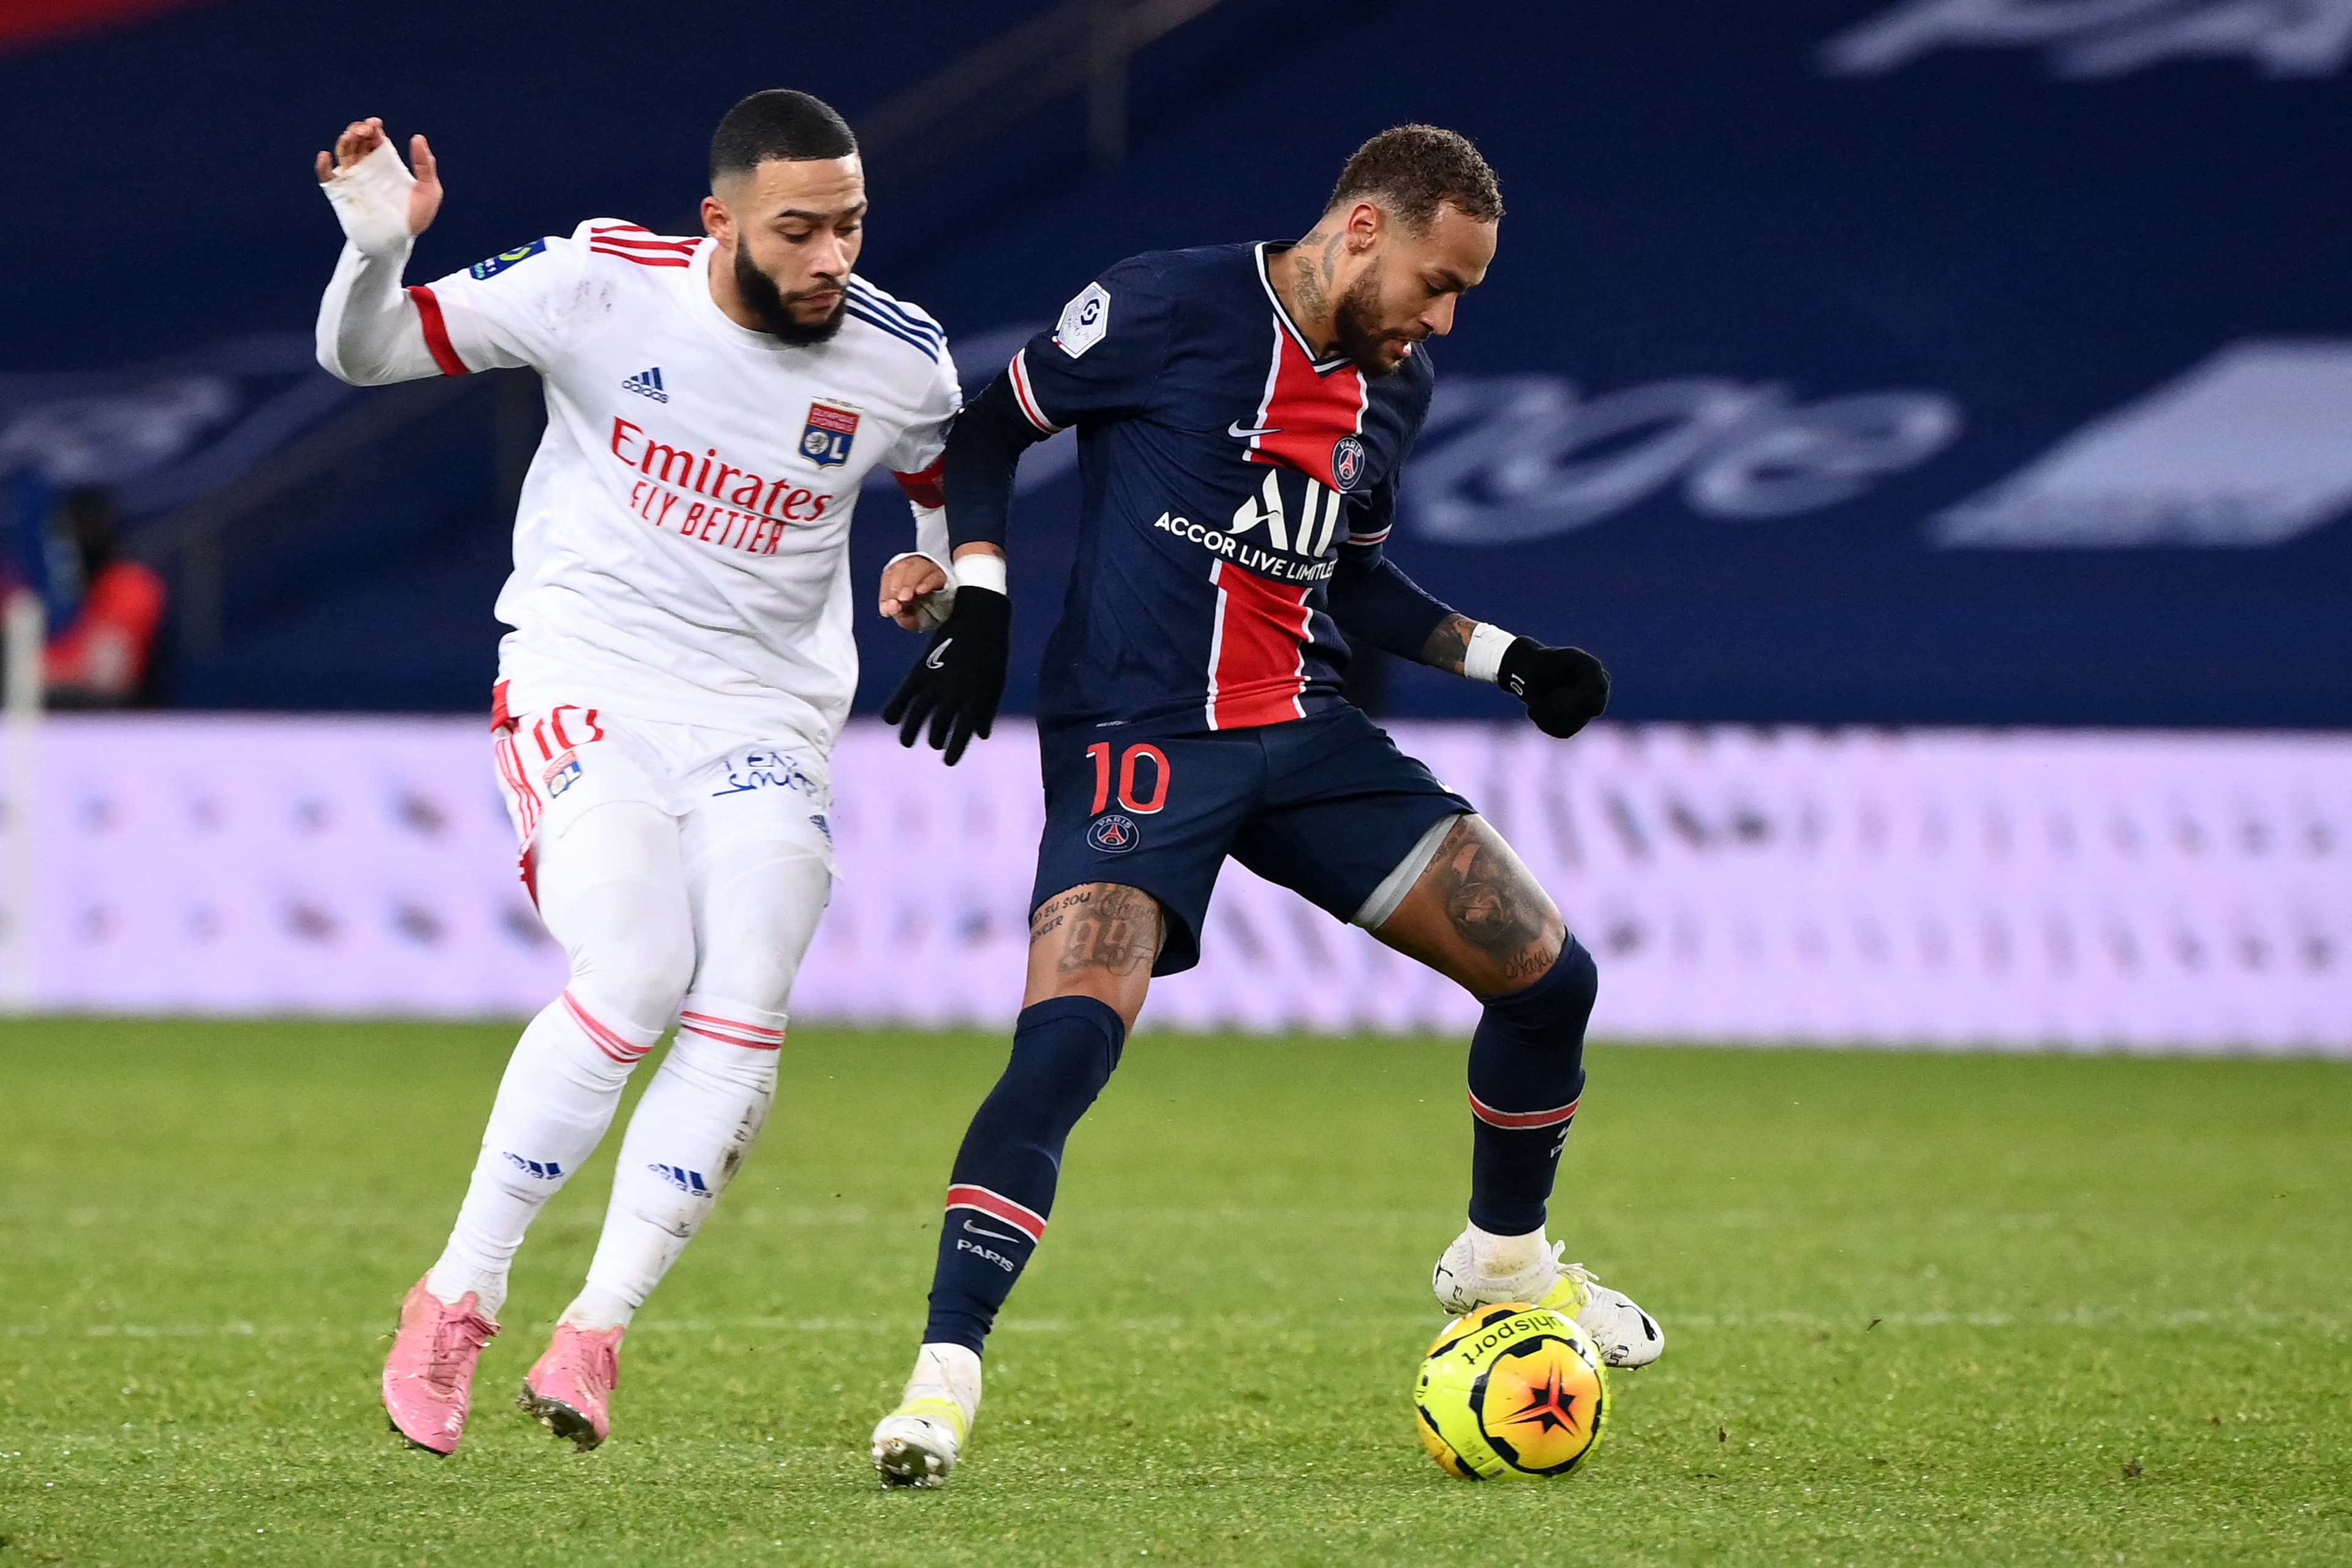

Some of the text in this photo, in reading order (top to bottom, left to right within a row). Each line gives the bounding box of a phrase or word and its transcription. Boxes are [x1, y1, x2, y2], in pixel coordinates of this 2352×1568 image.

[611, 415, 832, 522] Emirates
[1340, 440, 1362, 458] PARIS
[630, 481, 786, 555] FLY BETTER
[1154, 511, 1339, 581] ACCOR LIVE LIMITLE
[1086, 741, 1171, 816] 10
[1098, 816, 1133, 829] PARIS
[1062, 892, 1091, 909] SOU
[957, 1238, 1015, 1272] PARIS
[1461, 1315, 1564, 1366] uhlsport
